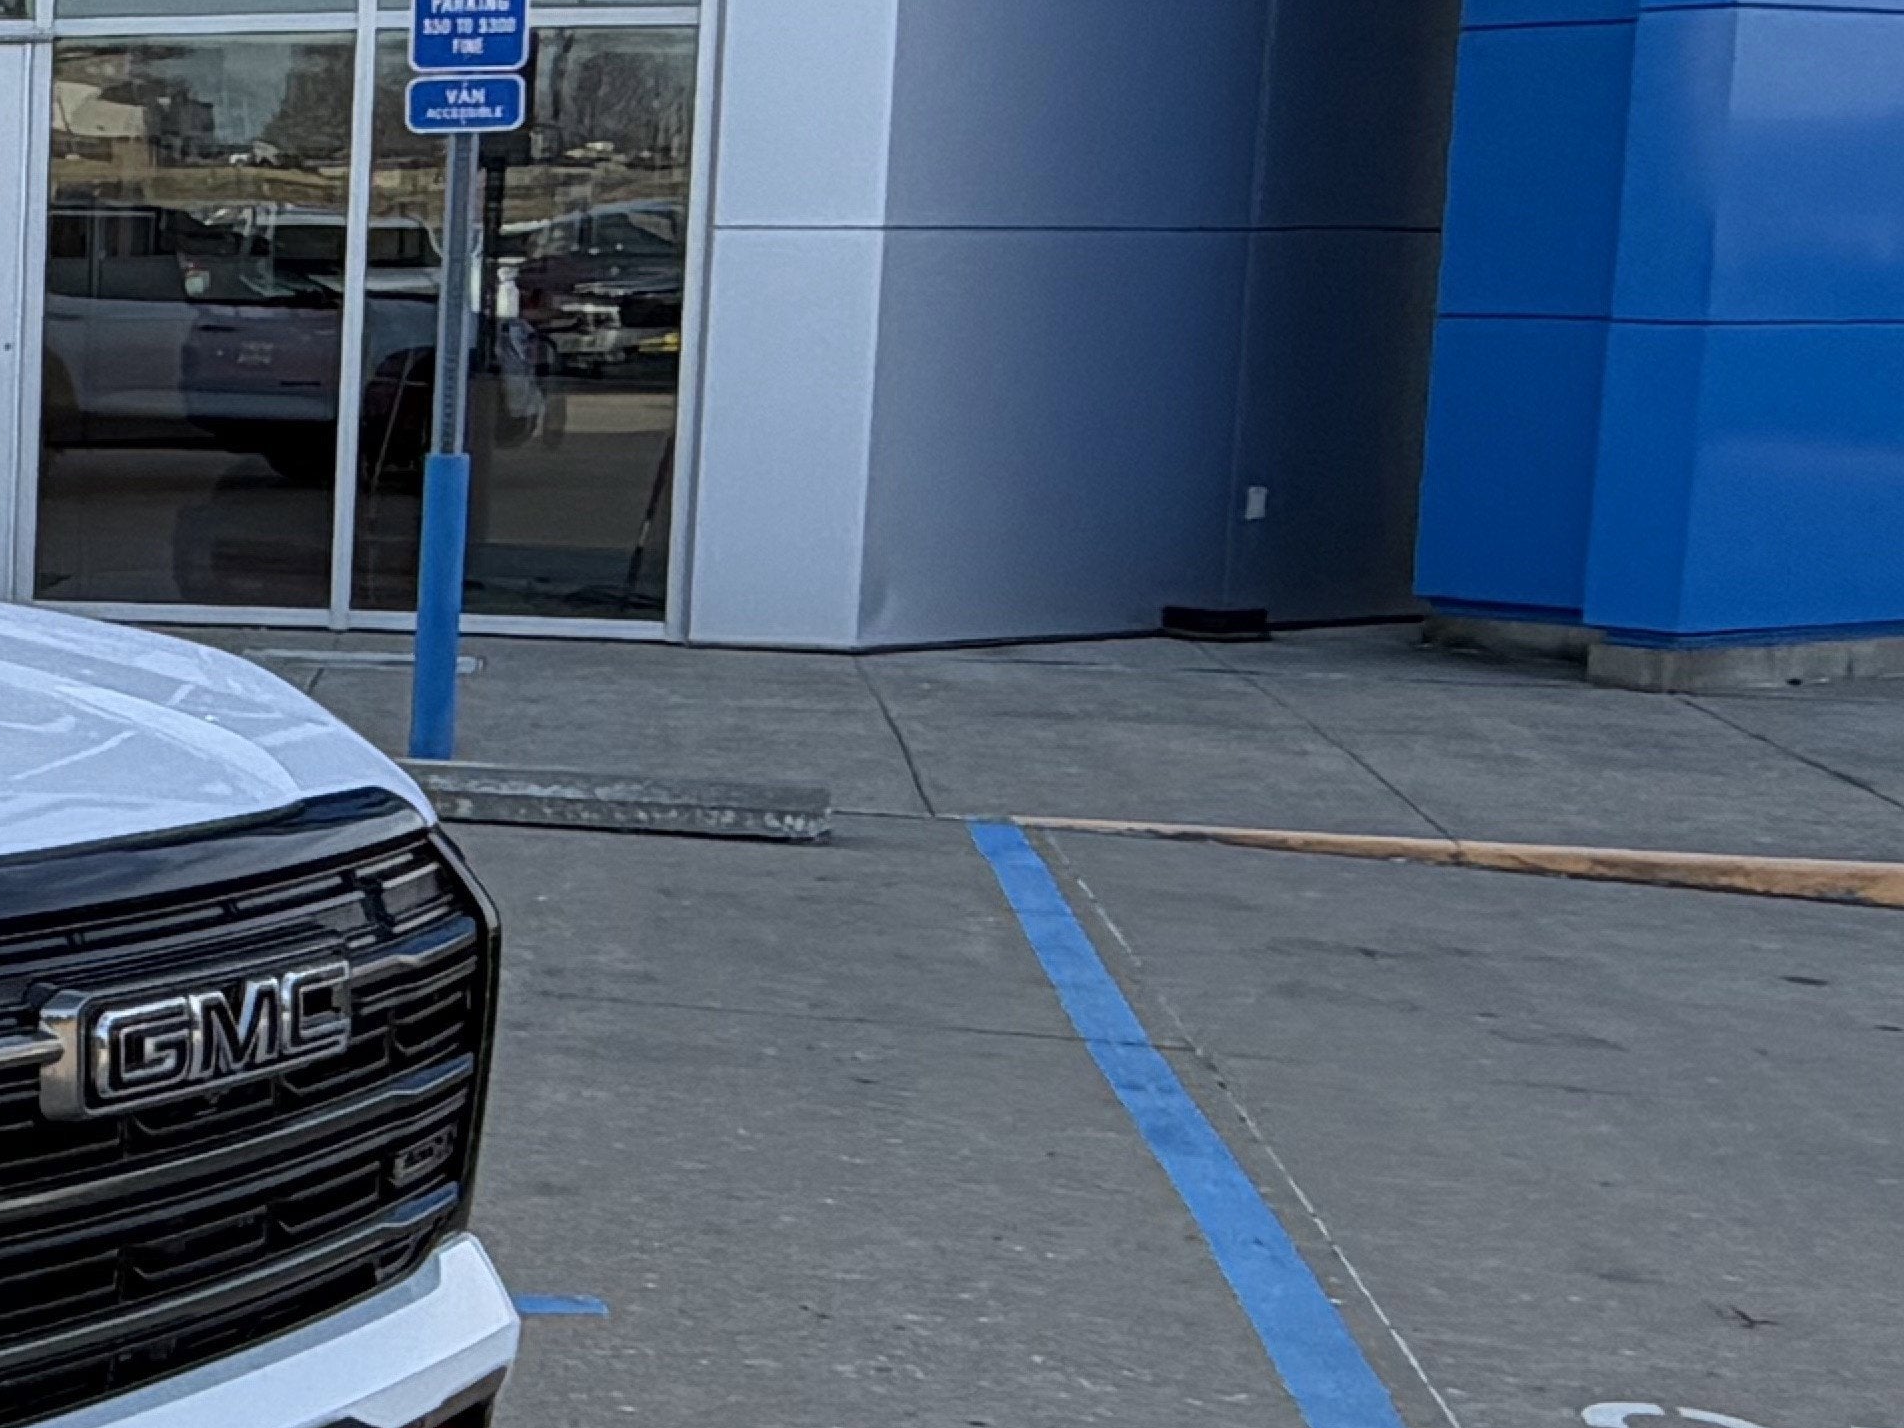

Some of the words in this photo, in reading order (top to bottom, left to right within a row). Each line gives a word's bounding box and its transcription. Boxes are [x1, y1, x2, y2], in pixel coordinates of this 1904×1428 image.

[452, 38, 484, 54] FINE
[446, 88, 485, 104] VAN
[94, 960, 350, 1098] GMC
